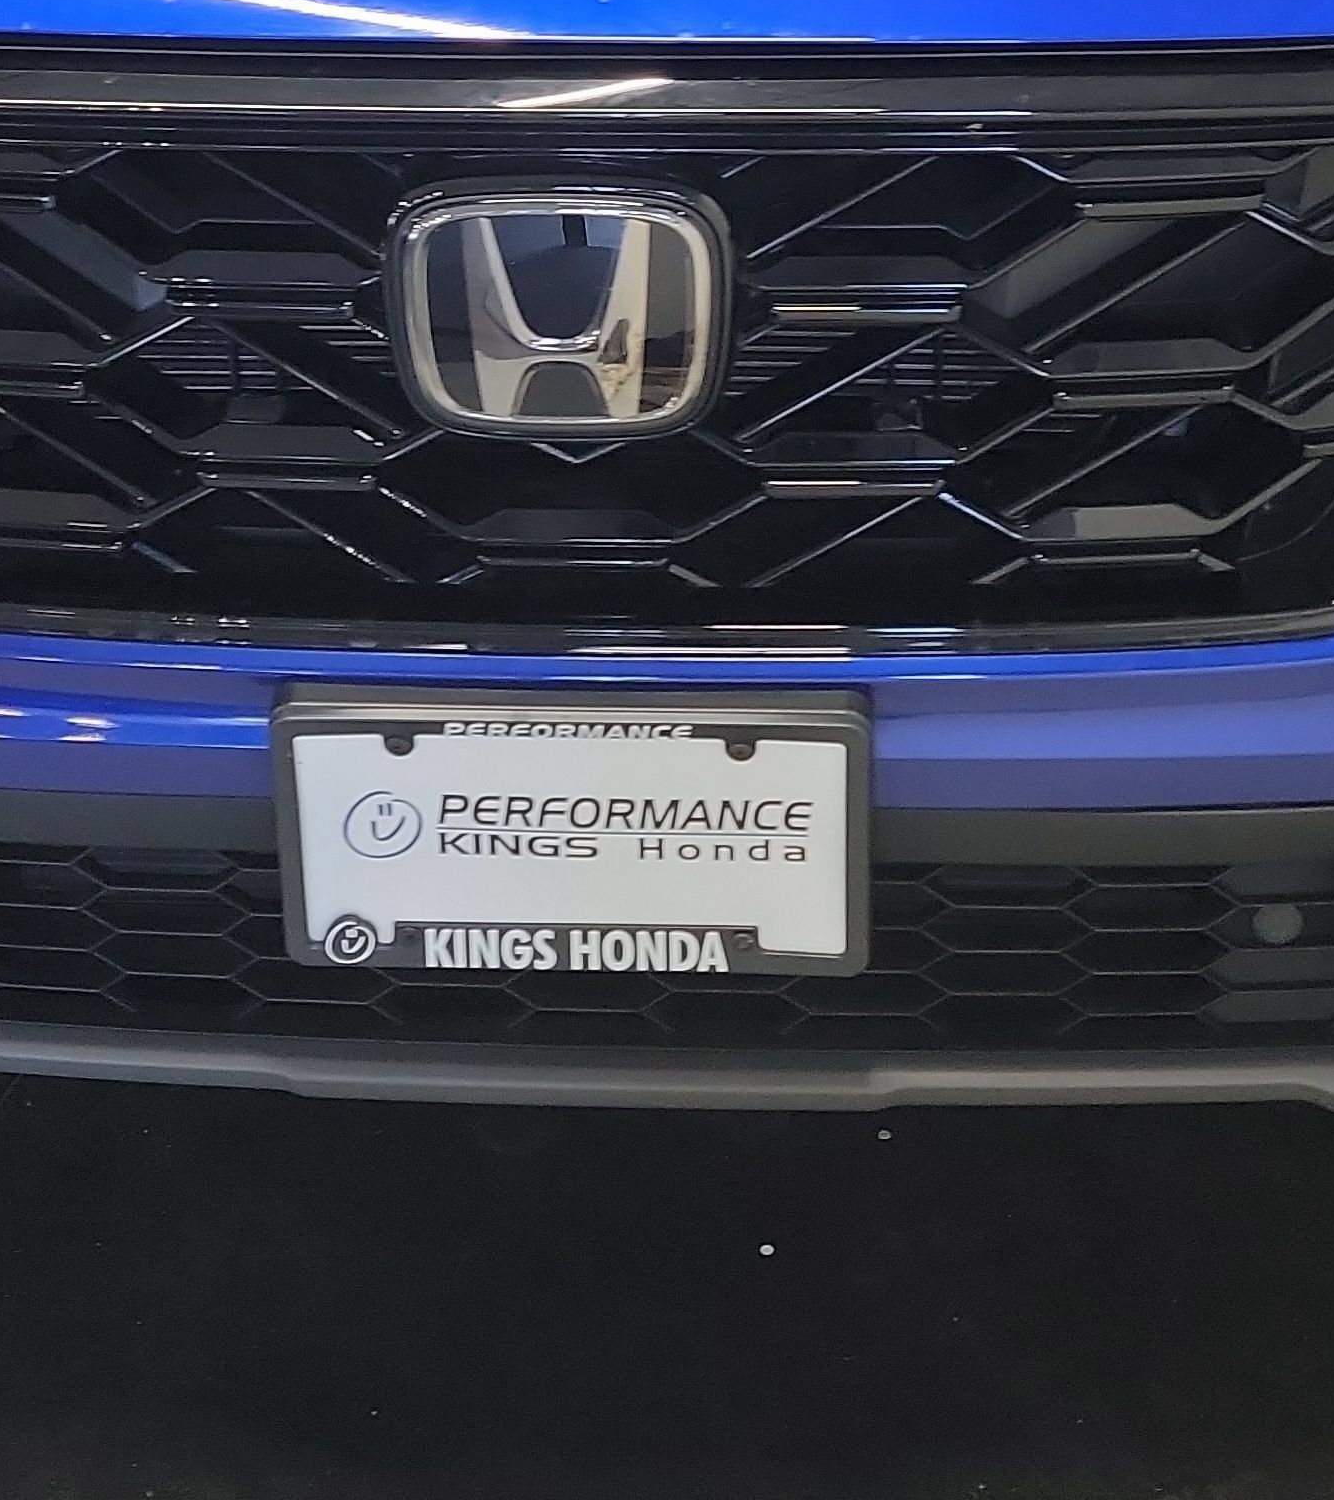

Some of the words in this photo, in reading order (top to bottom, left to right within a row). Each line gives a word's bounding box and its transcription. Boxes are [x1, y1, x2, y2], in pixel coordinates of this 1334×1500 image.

[442, 722, 694, 740] PERFORMANCE
[439, 794, 814, 831] PERFORMANCE
[439, 832, 599, 859] KINGS
[639, 838, 807, 863] Honda
[424, 928, 558, 970] KINGS
[570, 930, 729, 973] HONDA
